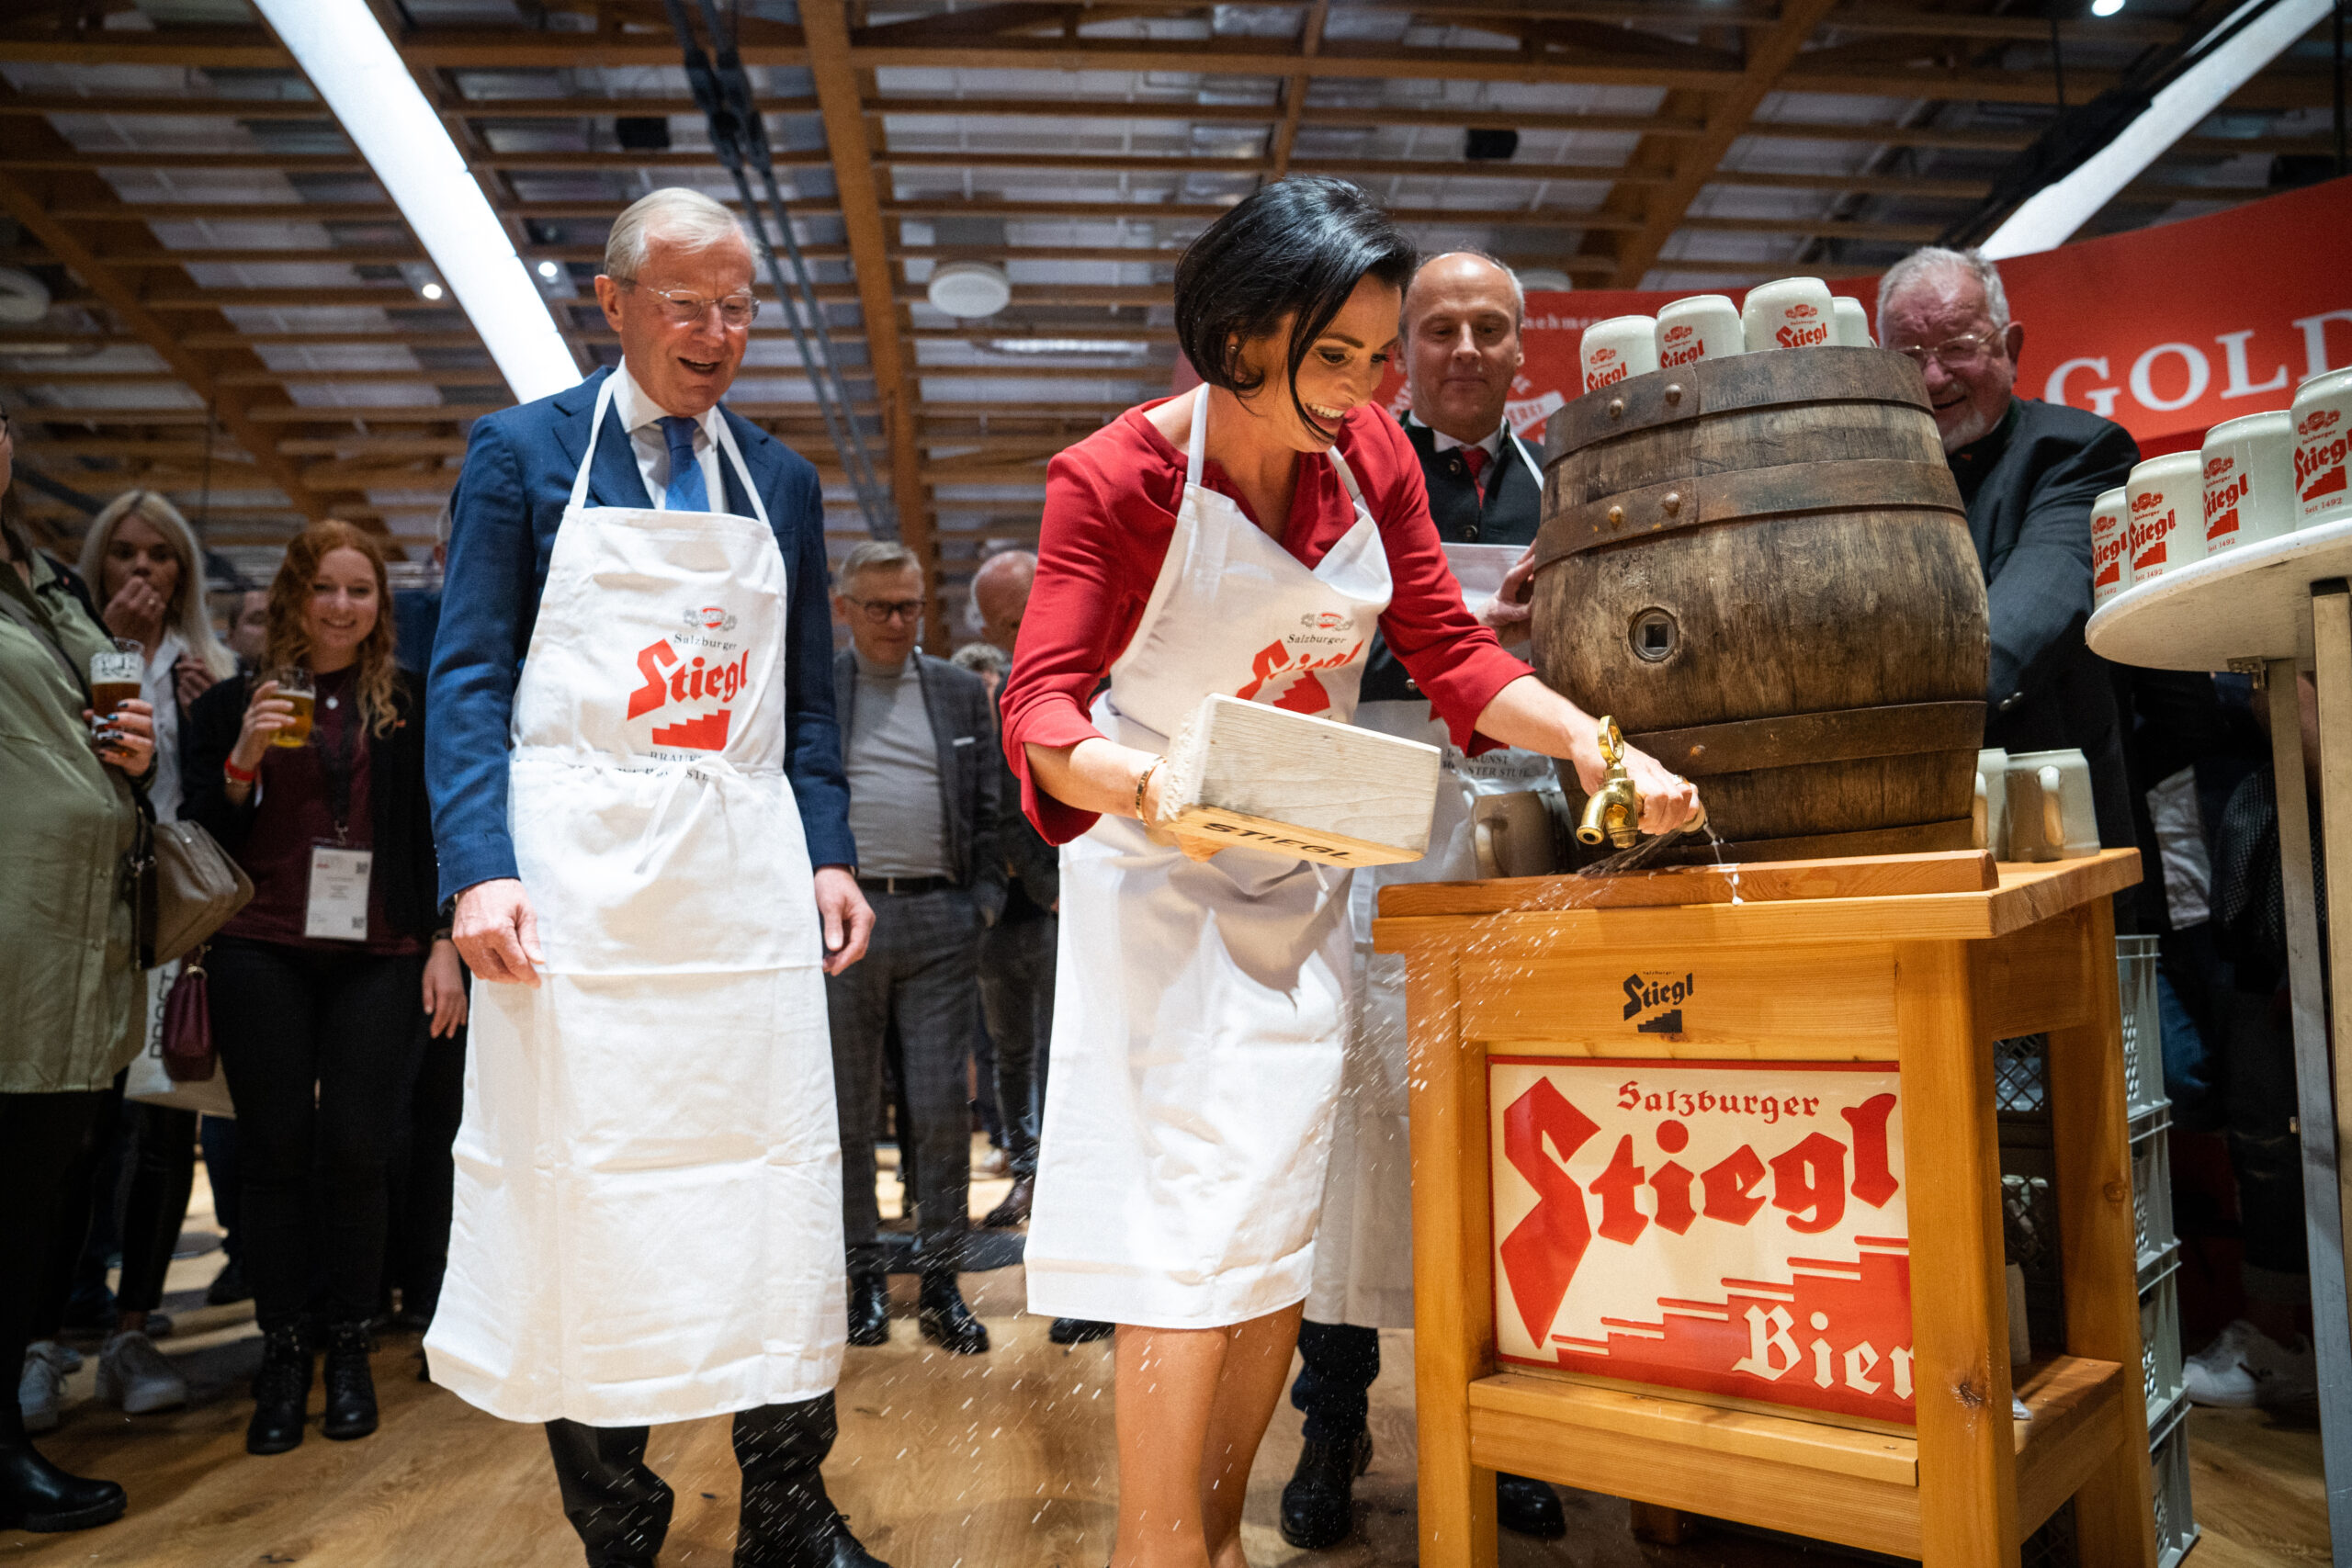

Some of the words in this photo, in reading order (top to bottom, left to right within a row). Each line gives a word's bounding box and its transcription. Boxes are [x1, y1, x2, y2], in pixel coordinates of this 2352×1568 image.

[1776, 321, 1827, 348] Stiegl
[2322, 497, 2343, 509] 1492
[2092, 530, 2128, 570] tiegl
[2220, 537, 2235, 548] 1492
[2147, 569, 2163, 579] 1492
[673, 633, 738, 650] Salzburger
[1287, 633, 1348, 645] Salzburger
[627, 638, 750, 721] Stiegl
[1203, 823, 1351, 861] STIEGL
[1623, 972, 1693, 1021] Stiegl
[1617, 1080, 1820, 1124] Salzburger
[1499, 1076, 1899, 1349] Stiegl
[1732, 1303, 1916, 1400] Bier
